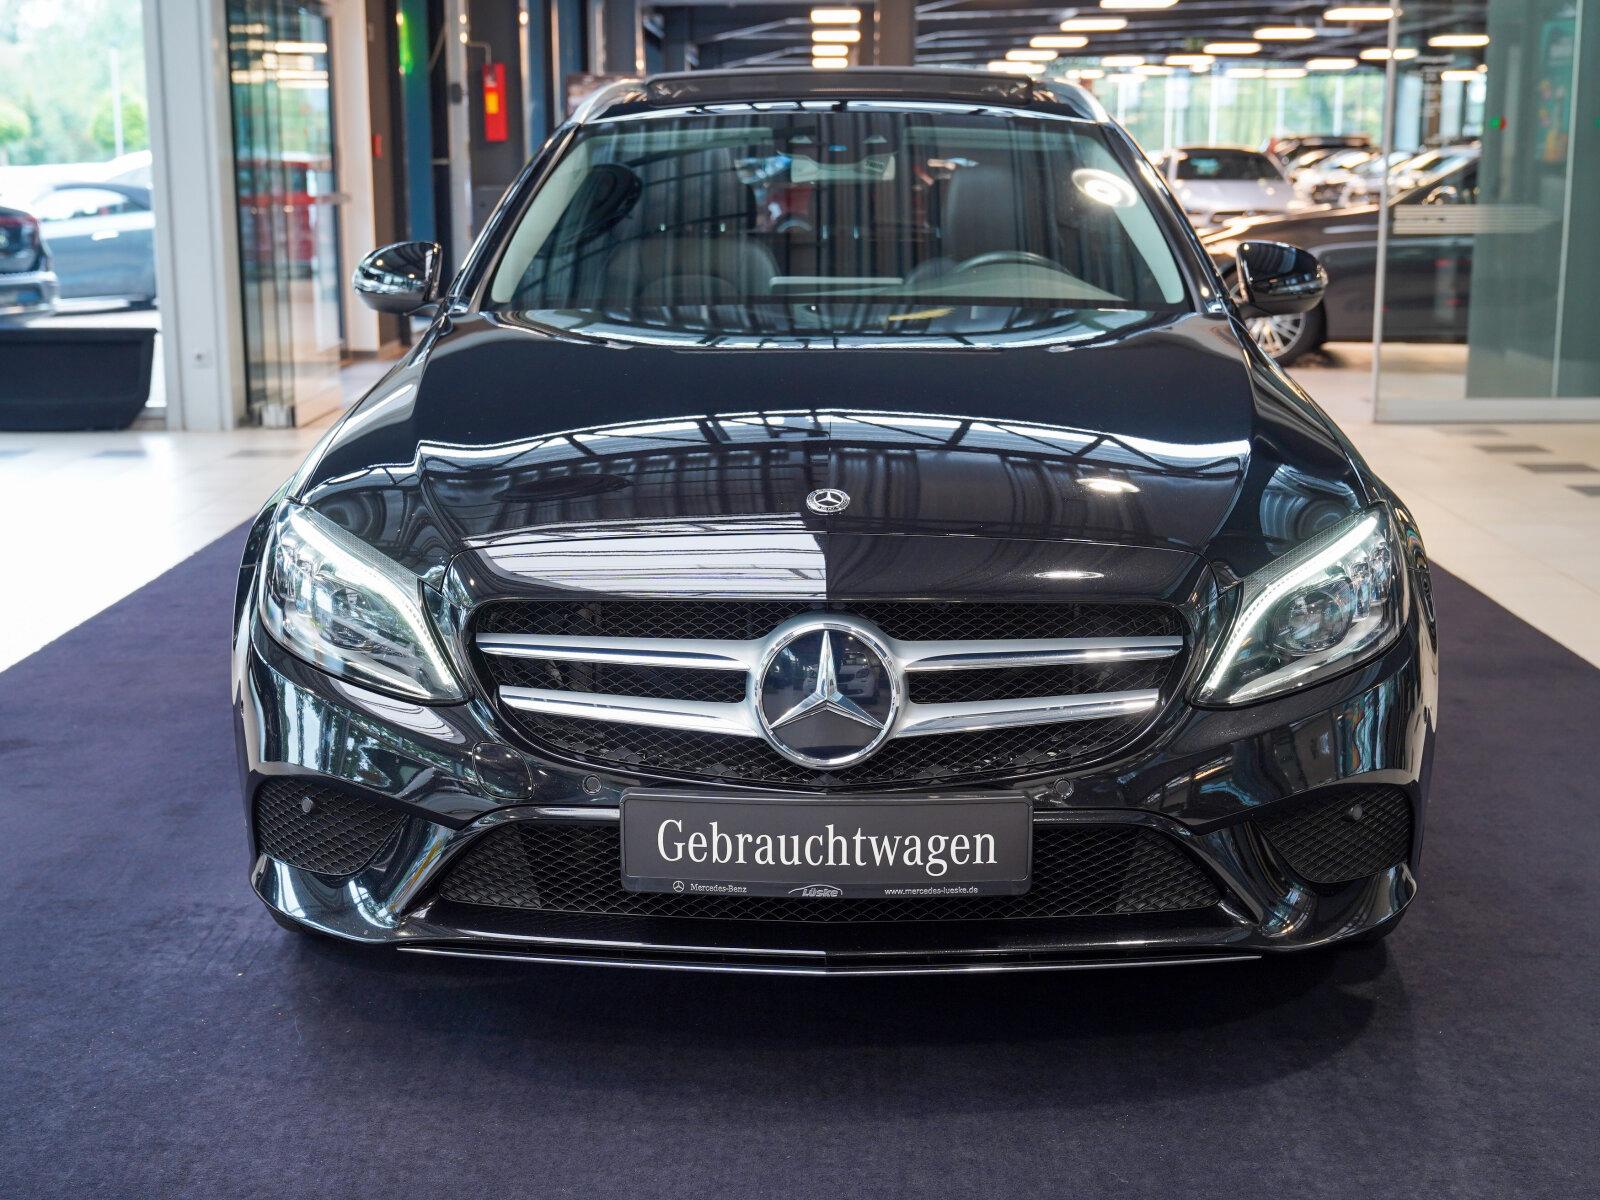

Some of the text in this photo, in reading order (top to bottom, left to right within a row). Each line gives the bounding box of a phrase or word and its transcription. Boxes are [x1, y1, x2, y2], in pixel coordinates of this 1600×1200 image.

[657, 819, 998, 877] Gebrauchtwagen
[690, 883, 748, 893] Mercedes-Benz
[884, 886, 979, 895] www.mercedes-lueske.de
